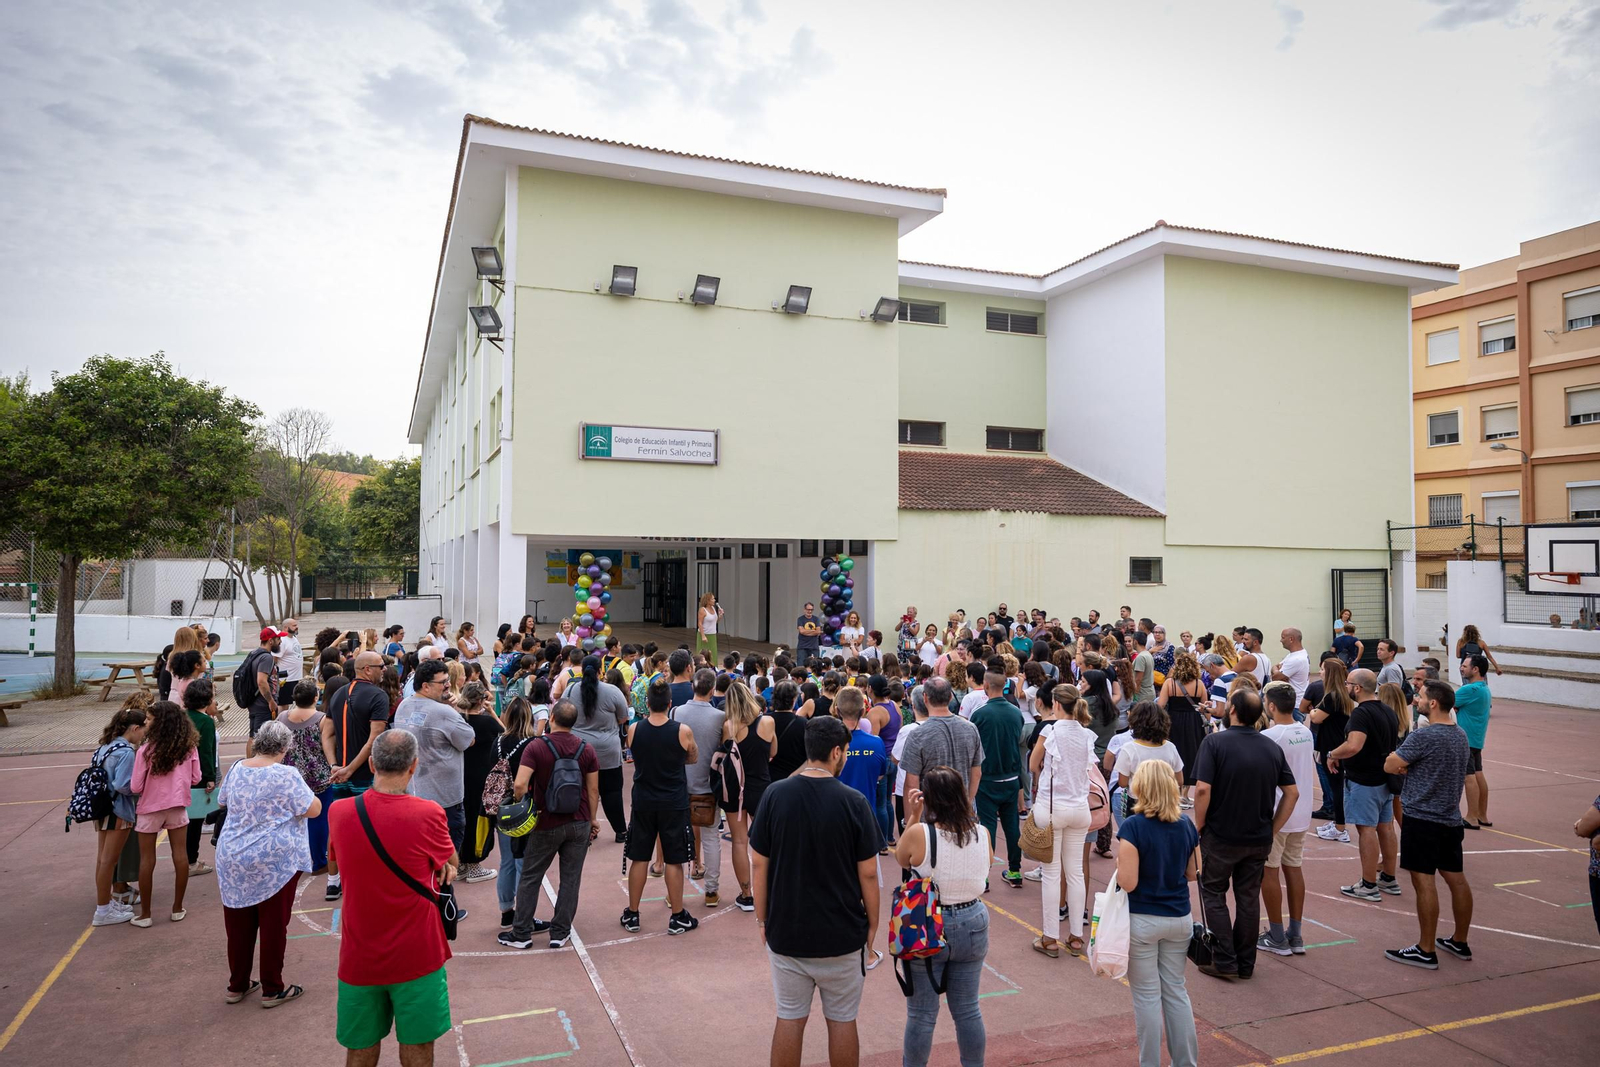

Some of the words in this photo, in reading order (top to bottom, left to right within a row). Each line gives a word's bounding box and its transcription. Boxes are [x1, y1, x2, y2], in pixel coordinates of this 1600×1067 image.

[614, 436, 633, 445] Colegio
[642, 437, 668, 446] Educación
[669, 439, 686, 447] Infantil
[691, 440, 712, 448] Primaria
[637, 446, 668, 456] Fermín
[670, 448, 712, 458] Salvochea
